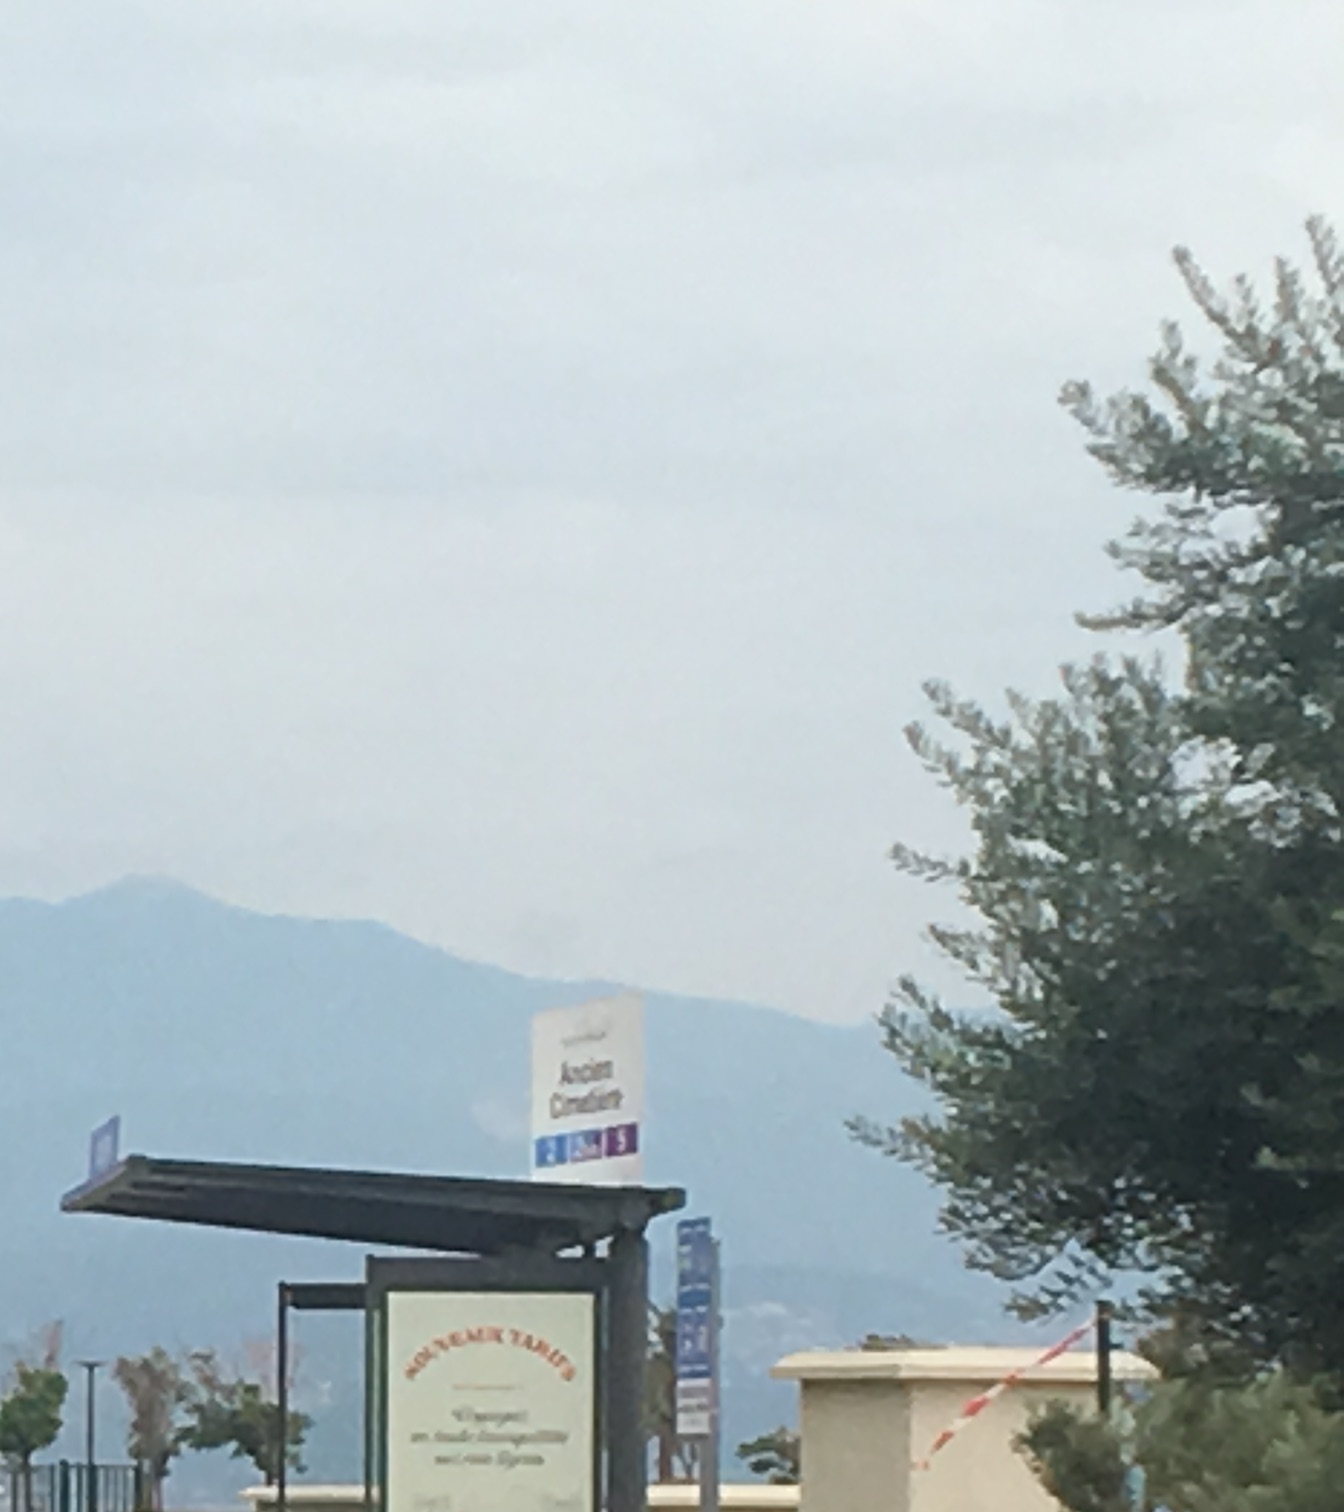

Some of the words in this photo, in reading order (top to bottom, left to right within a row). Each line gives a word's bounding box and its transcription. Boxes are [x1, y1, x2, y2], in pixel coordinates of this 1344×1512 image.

[560, 1058, 614, 1086] Ancien
[404, 1326, 504, 1380] NOUVEAUX
[510, 1329, 577, 1381] TARIFS
